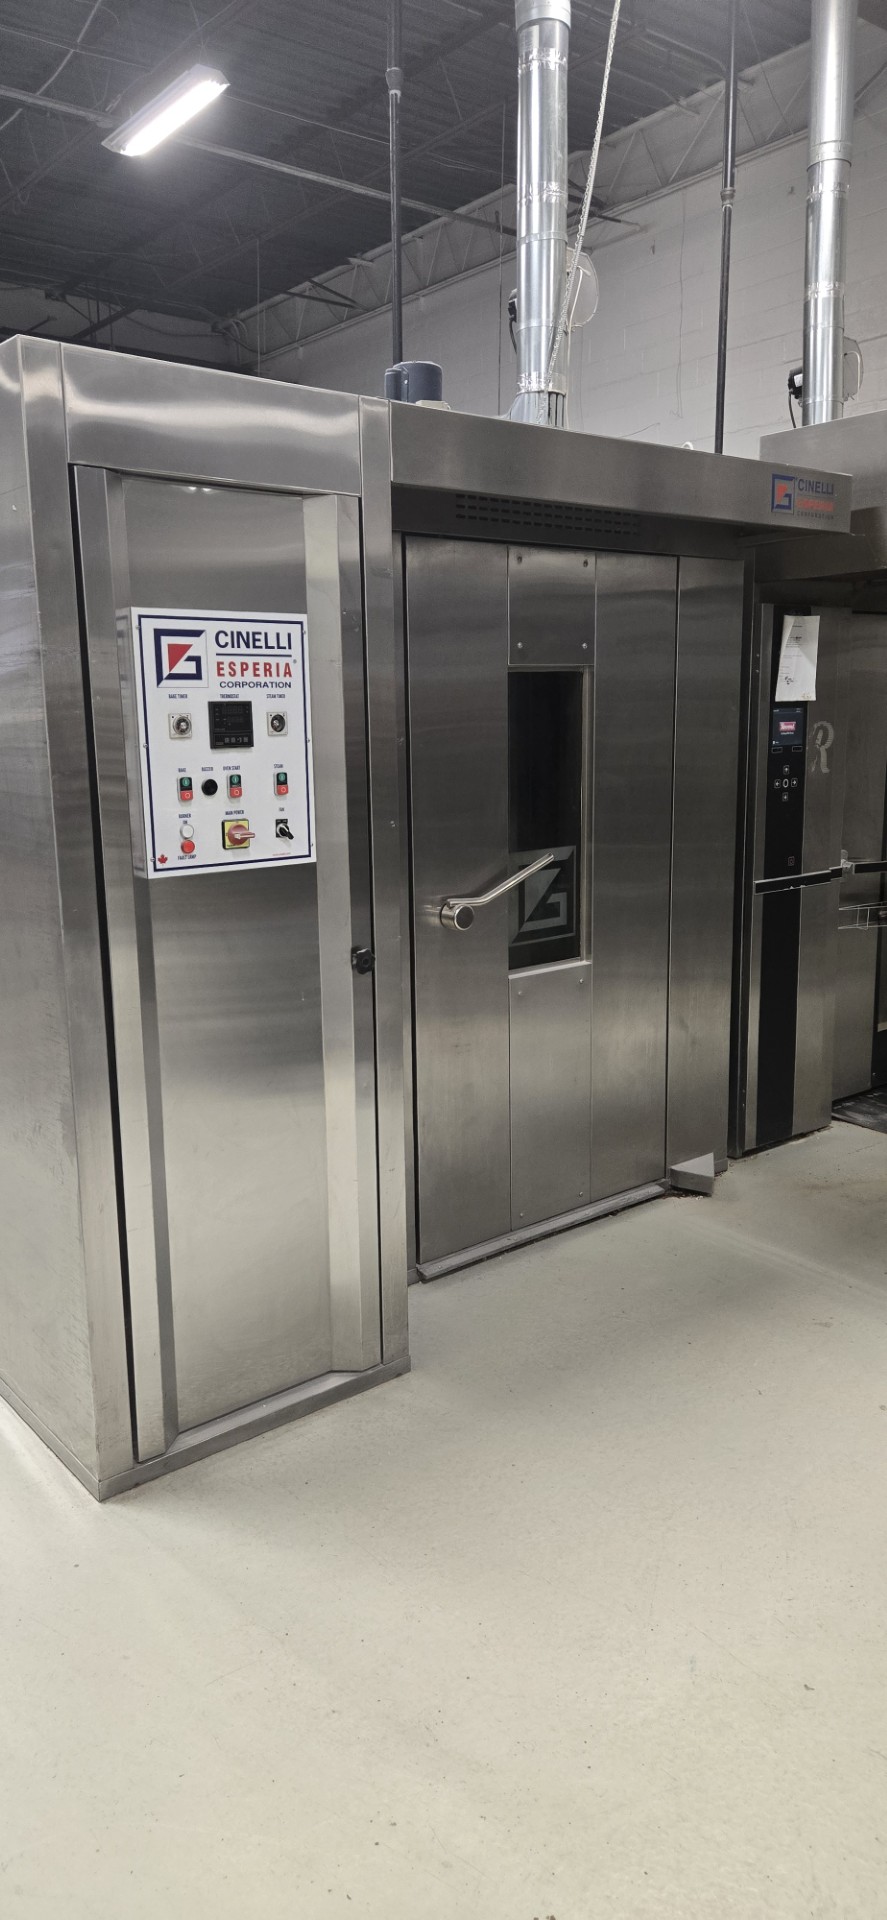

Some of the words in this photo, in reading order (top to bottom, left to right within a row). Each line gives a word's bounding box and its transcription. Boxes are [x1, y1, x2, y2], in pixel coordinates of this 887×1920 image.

[797, 479, 834, 495] CINELLI
[214, 630, 292, 650] CINELLI
[216, 661, 292, 678] ESPERIA
[219, 681, 292, 689] CORPORATION
